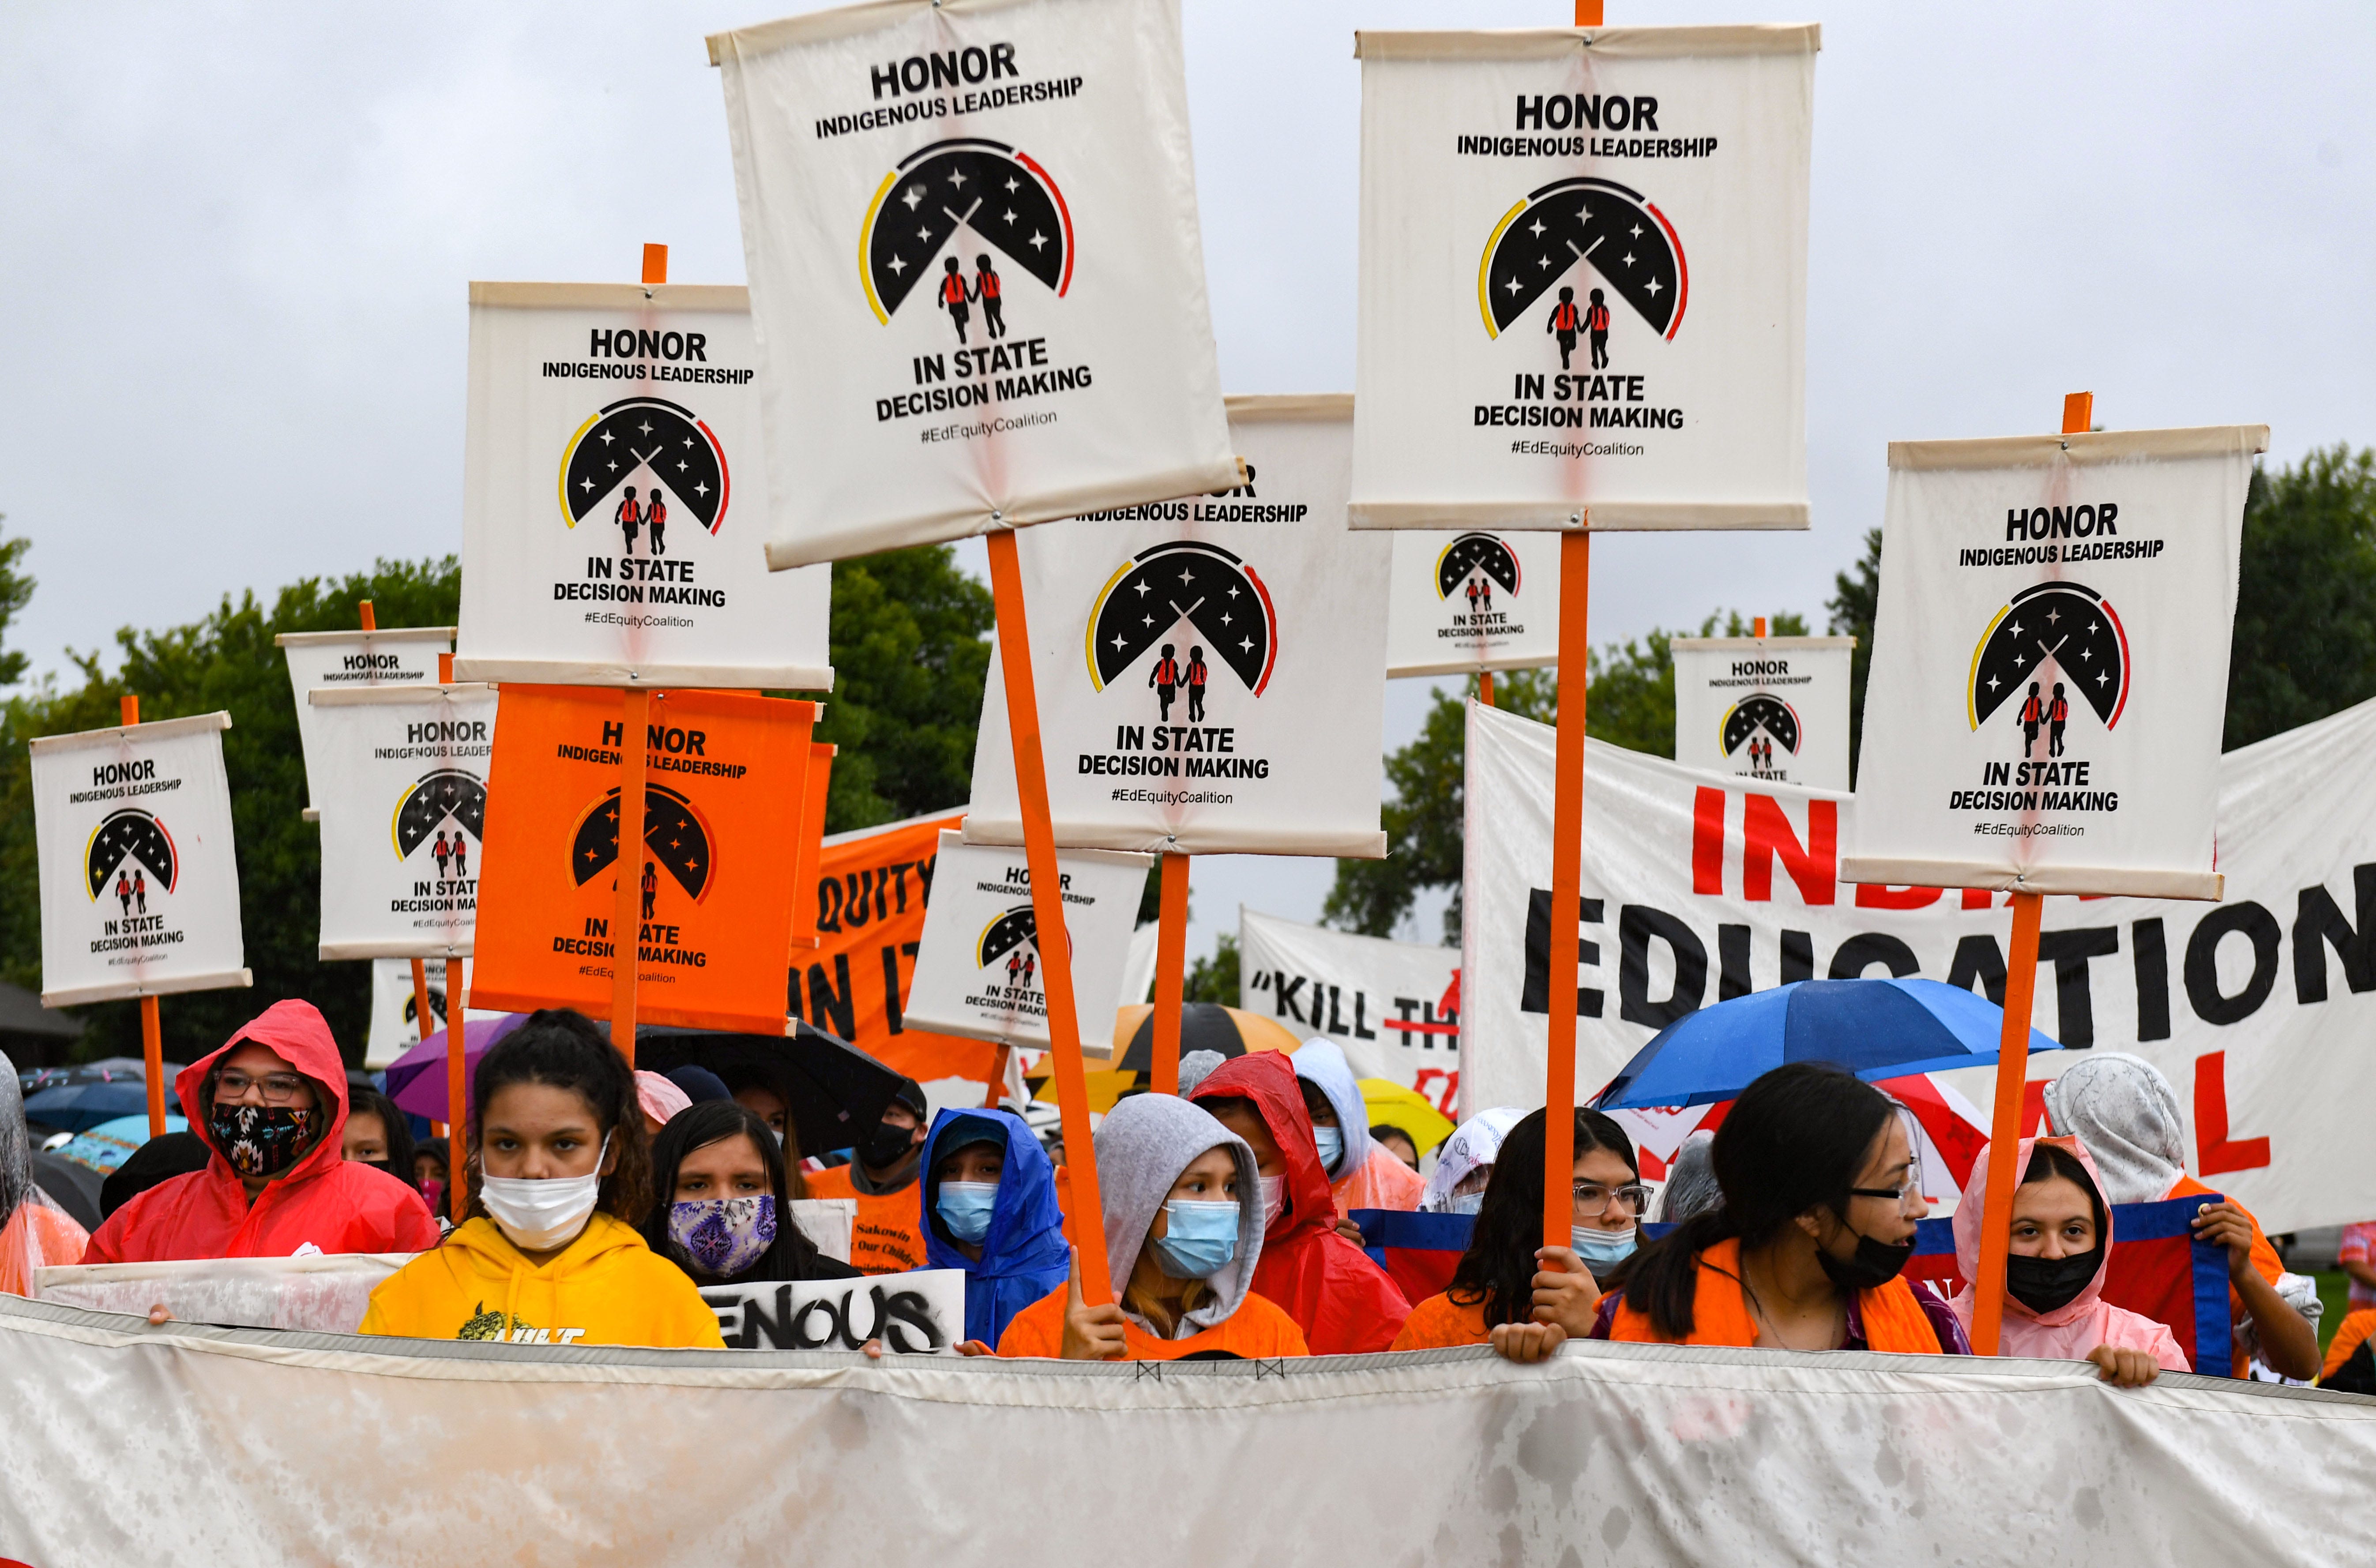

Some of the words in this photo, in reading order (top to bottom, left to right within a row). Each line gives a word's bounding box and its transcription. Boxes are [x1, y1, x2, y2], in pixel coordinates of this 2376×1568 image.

[870, 41, 1019, 101] HONOR
[816, 98, 947, 139] INDIGENOUS
[953, 77, 1083, 116] LEADERSHIP
[1516, 94, 1658, 132] HONOR
[1457, 136, 1585, 156] INDIGENOUS
[1590, 137, 1718, 158] LEADERSHIP
[590, 329, 707, 361] HONOR
[913, 353, 944, 385] IN
[955, 338, 1048, 378] STATE
[542, 362, 647, 380] INDIGENOUS
[651, 366, 754, 385] LEADERSHIP
[876, 384, 989, 422] DECISION
[996, 365, 1092, 401] MAKING
[1515, 373, 1545, 400] IN
[1553, 375, 1645, 401] STATE
[920, 410, 1057, 444] #EdEquityCoalition
[1474, 406, 1583, 428] DECISION
[1590, 407, 1684, 430] MAKING
[1511, 440, 1644, 459] #EdEquityCoalition
[1194, 504, 1308, 523] LEADERSHIP
[2006, 503, 2118, 541] HONOR
[1959, 545, 2058, 567] INDIGENOUS
[2062, 539, 2164, 563] LEADERSHIP
[587, 557, 612, 579] IN
[620, 558, 694, 583] STATE
[554, 583, 643, 603] DECISION
[649, 587, 726, 608] MAKING
[584, 612, 694, 629] #EdEquityCoalition
[1454, 615, 1466, 626] IN
[1470, 613, 1507, 625] STATE
[1438, 628, 1483, 638] DECISION
[1486, 625, 1524, 635] MAKING
[343, 654, 400, 670] HONOR
[1732, 661, 1788, 676] HONOR
[323, 671, 373, 682] INDIGENOUS
[375, 670, 425, 680] LEADERSHIP
[1709, 678, 1760, 687] INDIGENOUS
[1762, 677, 1812, 685] LEADERSHIP
[407, 721, 487, 744] HONOR
[602, 721, 707, 756] HNOR
[1117, 725, 1144, 750] IN
[1151, 726, 1234, 752] STATE
[375, 747, 447, 760] INDIGENOUS
[451, 745, 492, 757] LEADER
[557, 744, 650, 768] INDIGEN
[654, 756, 747, 780] LEADERSHIP
[93, 759, 156, 786] HONOR
[1078, 755, 1179, 777] DECISION
[1185, 758, 1269, 778] MAKING
[1983, 762, 2010, 786] IN
[2015, 761, 2090, 786] STATE
[70, 787, 125, 804] INDIGENOUS
[128, 778, 181, 796] LEADERSHIP
[1111, 789, 1233, 806] #EdEquityCoalition
[1949, 791, 2037, 810] DECISION
[2041, 792, 2118, 812] MAKING
[1974, 823, 2085, 838] #EdEquityCoalition
[414, 881, 431, 897] IN
[435, 879, 478, 896] STAT
[1006, 867, 1071, 890] HOR
[391, 899, 454, 913] DECISION
[1062, 893, 1095, 906] ERSHIP
[105, 921, 118, 936] IN
[122, 915, 164, 934] STATE
[585, 917, 608, 938] IN
[624, 923, 680, 945] ATE
[90, 936, 138, 953] DECISION
[141, 930, 184, 948] MAKING
[553, 936, 615, 958] DECISI
[637, 946, 707, 968] MAKING
[108, 953, 168, 966] #EdEquityCoalition
[579, 964, 676, 984] #EdEqoalition
[788, 954, 856, 1042] N
[986, 985, 1000, 997] IN
[1004, 987, 1044, 1004] STATE
[966, 996, 1015, 1010] DECISION
[1018, 1003, 1047, 1017] MAKI
[857, 1223, 910, 1243] Sakowin
[858, 1240, 880, 1252] Our
[882, 1243, 919, 1269] Childre
